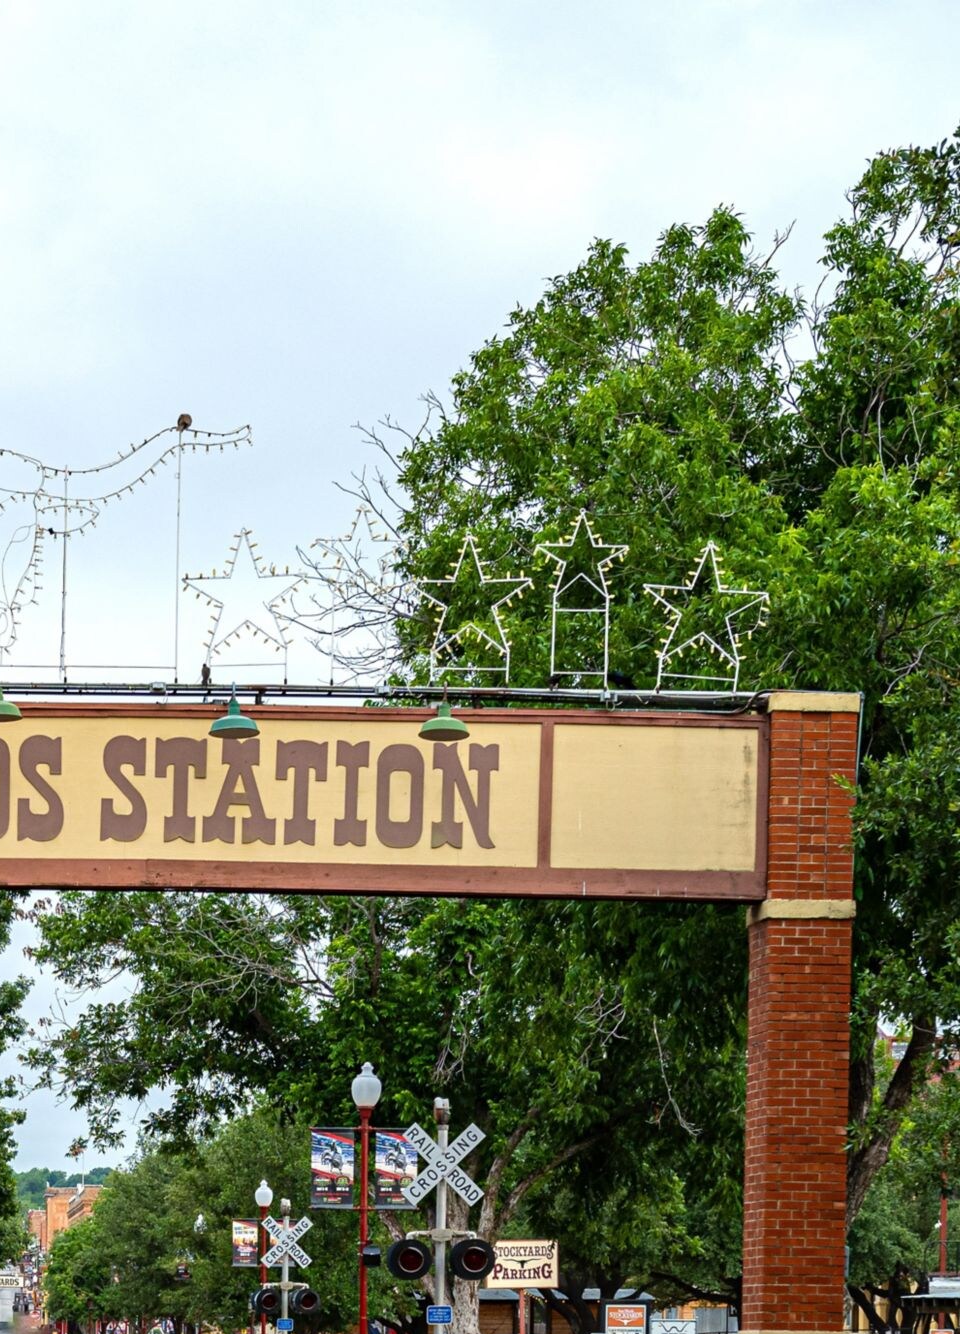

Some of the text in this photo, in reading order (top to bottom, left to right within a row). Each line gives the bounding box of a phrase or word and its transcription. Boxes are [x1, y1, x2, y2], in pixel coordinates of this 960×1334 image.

[100, 735, 499, 849] STATION
[407, 1127, 480, 1202] RAIL ROAD
[409, 1130, 478, 1198] CROSSING
[264, 1218, 283, 1239] RAIL
[289, 1243, 310, 1266] ROAD
[265, 1220, 309, 1264] CROSSING
[493, 1245, 554, 1260] STOCKYARDS
